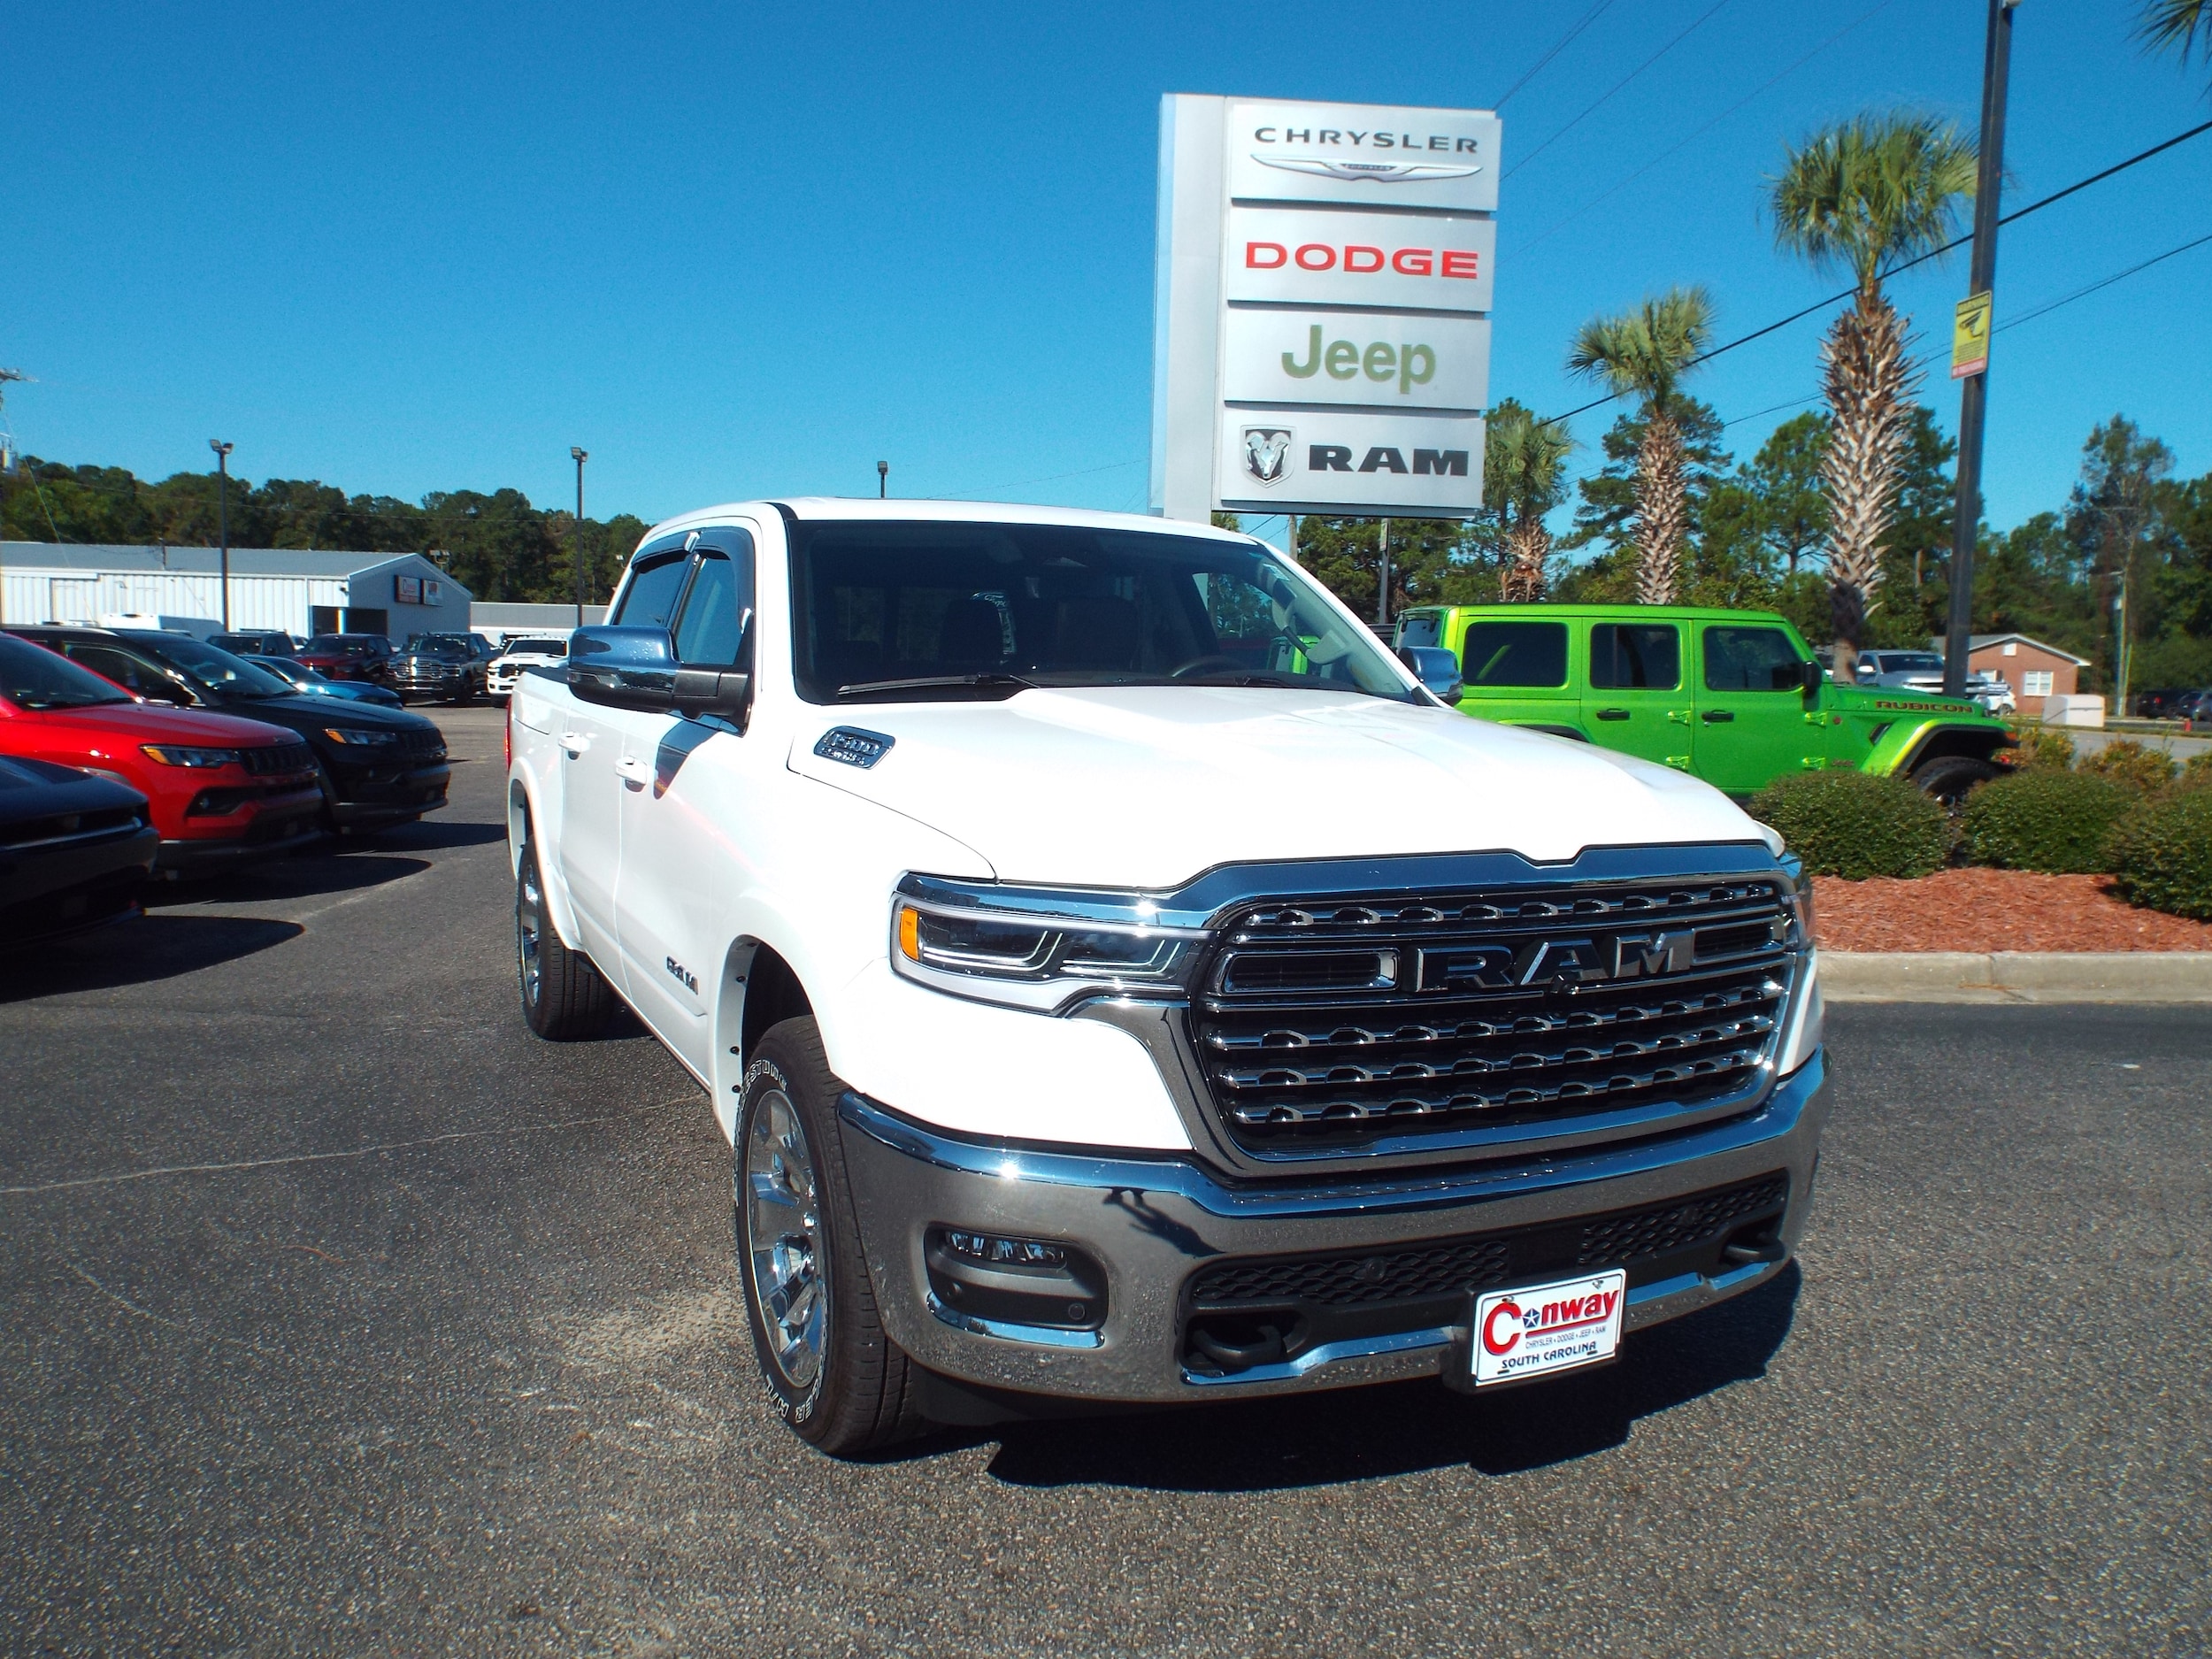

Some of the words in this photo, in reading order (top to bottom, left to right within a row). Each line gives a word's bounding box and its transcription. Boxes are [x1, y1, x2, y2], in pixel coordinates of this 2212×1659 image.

[1255, 127, 1479, 154] CHRYSLER
[1245, 242, 1479, 280] DODGE
[1281, 324, 1436, 395] Jeep
[1308, 444, 1469, 477] RAM
[1875, 701, 1973, 713] RUBICON
[1416, 929, 1694, 993] RAM
[1525, 1337, 1553, 1349] CHRYSLER
[1557, 1332, 1575, 1343] DODGE
[1579, 1328, 1591, 1338] JEEP
[1502, 1354, 1540, 1369] SOUTH
[1543, 1340, 1596, 1361] CAROLINA
